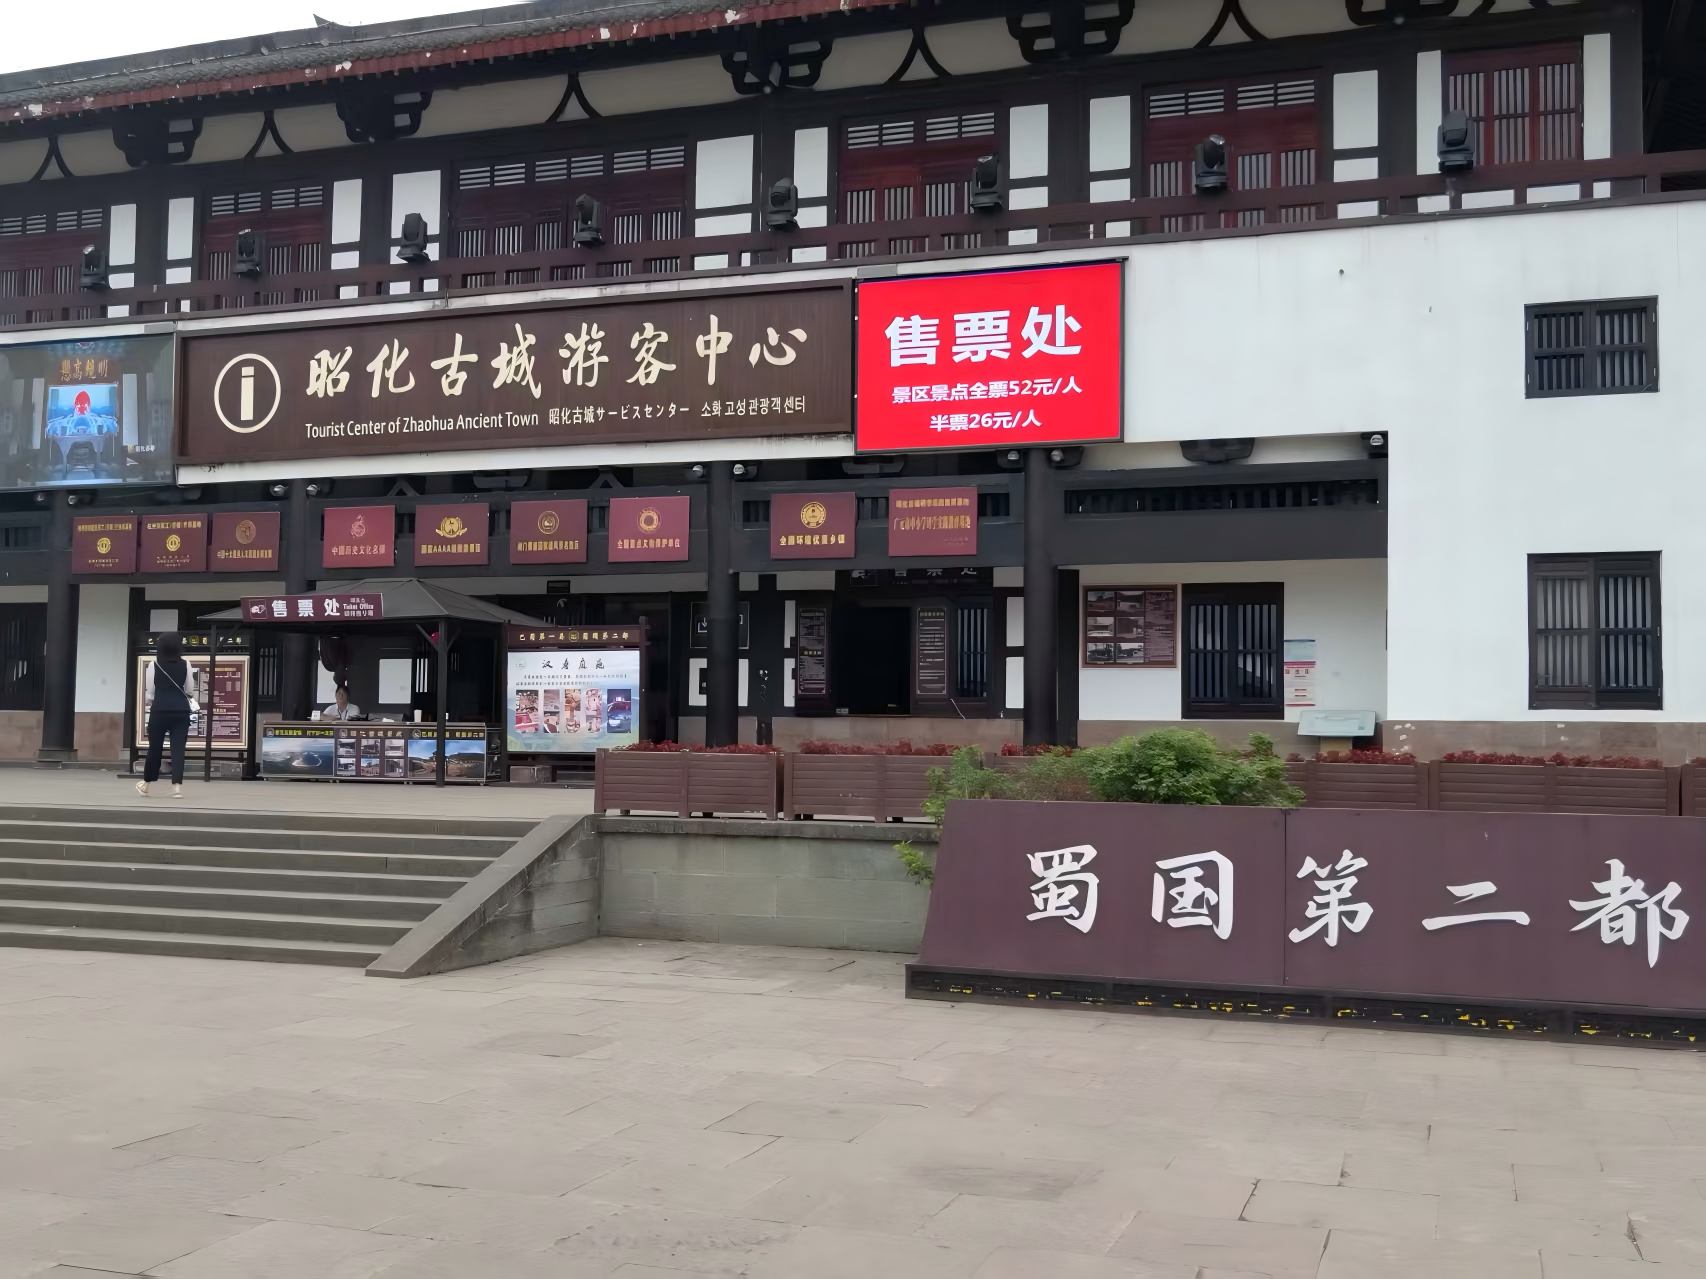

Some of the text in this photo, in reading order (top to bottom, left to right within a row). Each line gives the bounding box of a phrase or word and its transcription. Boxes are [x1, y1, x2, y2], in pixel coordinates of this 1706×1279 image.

[885, 304, 1082, 367] 售票处
[306, 314, 807, 399] 昭化古城游客中心
[891, 376, 1082, 404] 景区景点全票52元/人
[305, 411, 539, 439] Tourist Center of Zhaohua Ancient Town
[549, 401, 690, 425] 昭化古城サービスセンター
[929, 409, 1042, 432] 半票26元/人
[331, 544, 386, 555] 中国历史文化名
[617, 538, 680, 549] 全国点文保护单位
[271, 598, 341, 618] 售票处
[1026, 844, 1691, 969] 蜀国第二都
